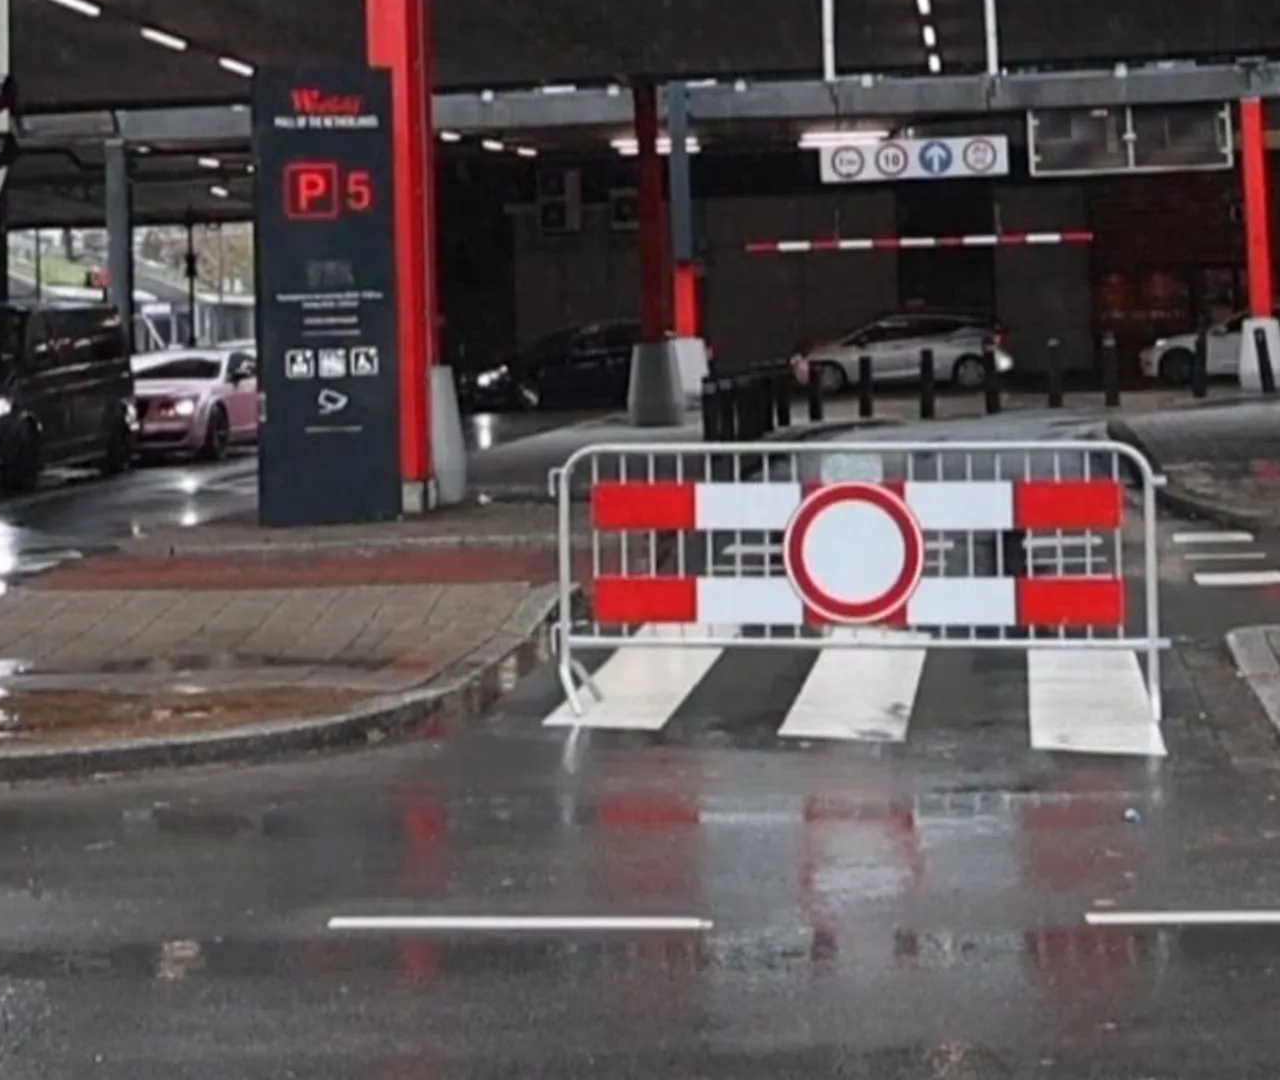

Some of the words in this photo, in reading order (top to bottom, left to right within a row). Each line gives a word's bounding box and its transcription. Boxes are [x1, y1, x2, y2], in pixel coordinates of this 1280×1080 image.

[883, 151, 901, 167] 10
[299, 173, 326, 211] P
[347, 172, 371, 211] 5
